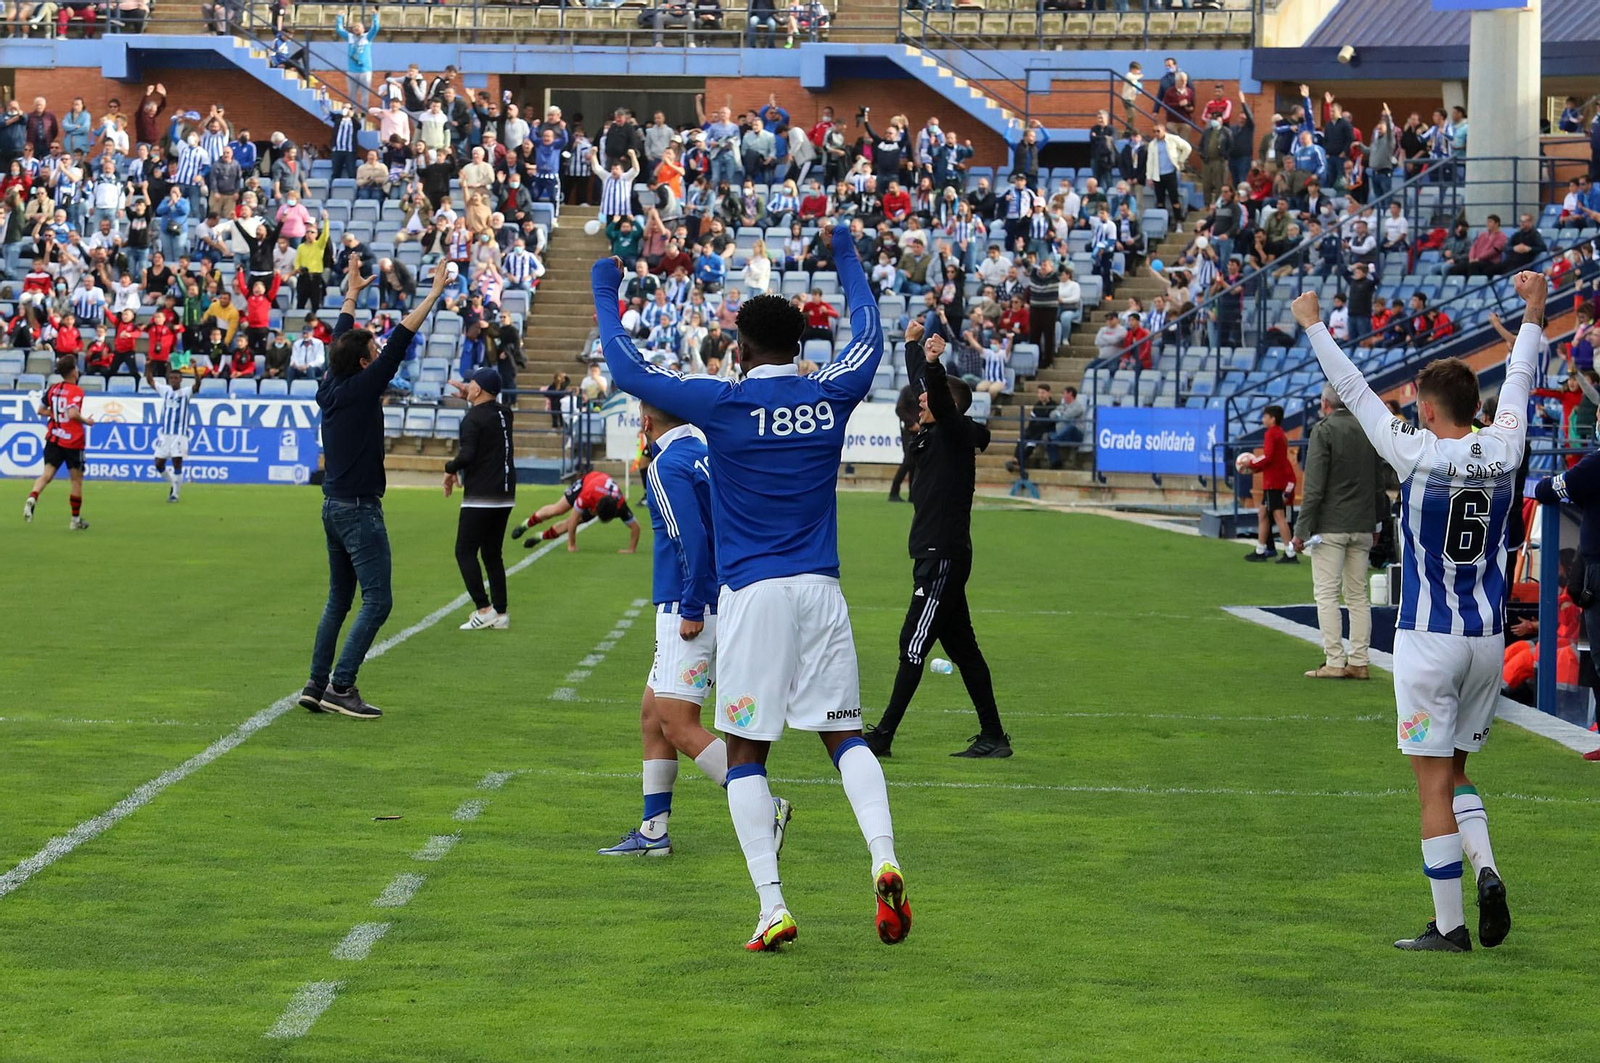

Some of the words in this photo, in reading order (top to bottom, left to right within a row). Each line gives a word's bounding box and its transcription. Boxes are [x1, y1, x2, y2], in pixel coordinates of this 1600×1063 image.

[51, 395, 70, 423] 19
[750, 401, 834, 436] 1889
[845, 434, 866, 449] pre
[870, 435, 891, 446] con
[1100, 428, 1142, 450] Grada
[1144, 430, 1195, 452] solidaria
[132, 464, 144, 478] Y
[1466, 461, 1504, 479] SALES
[1443, 486, 1492, 565] 6
